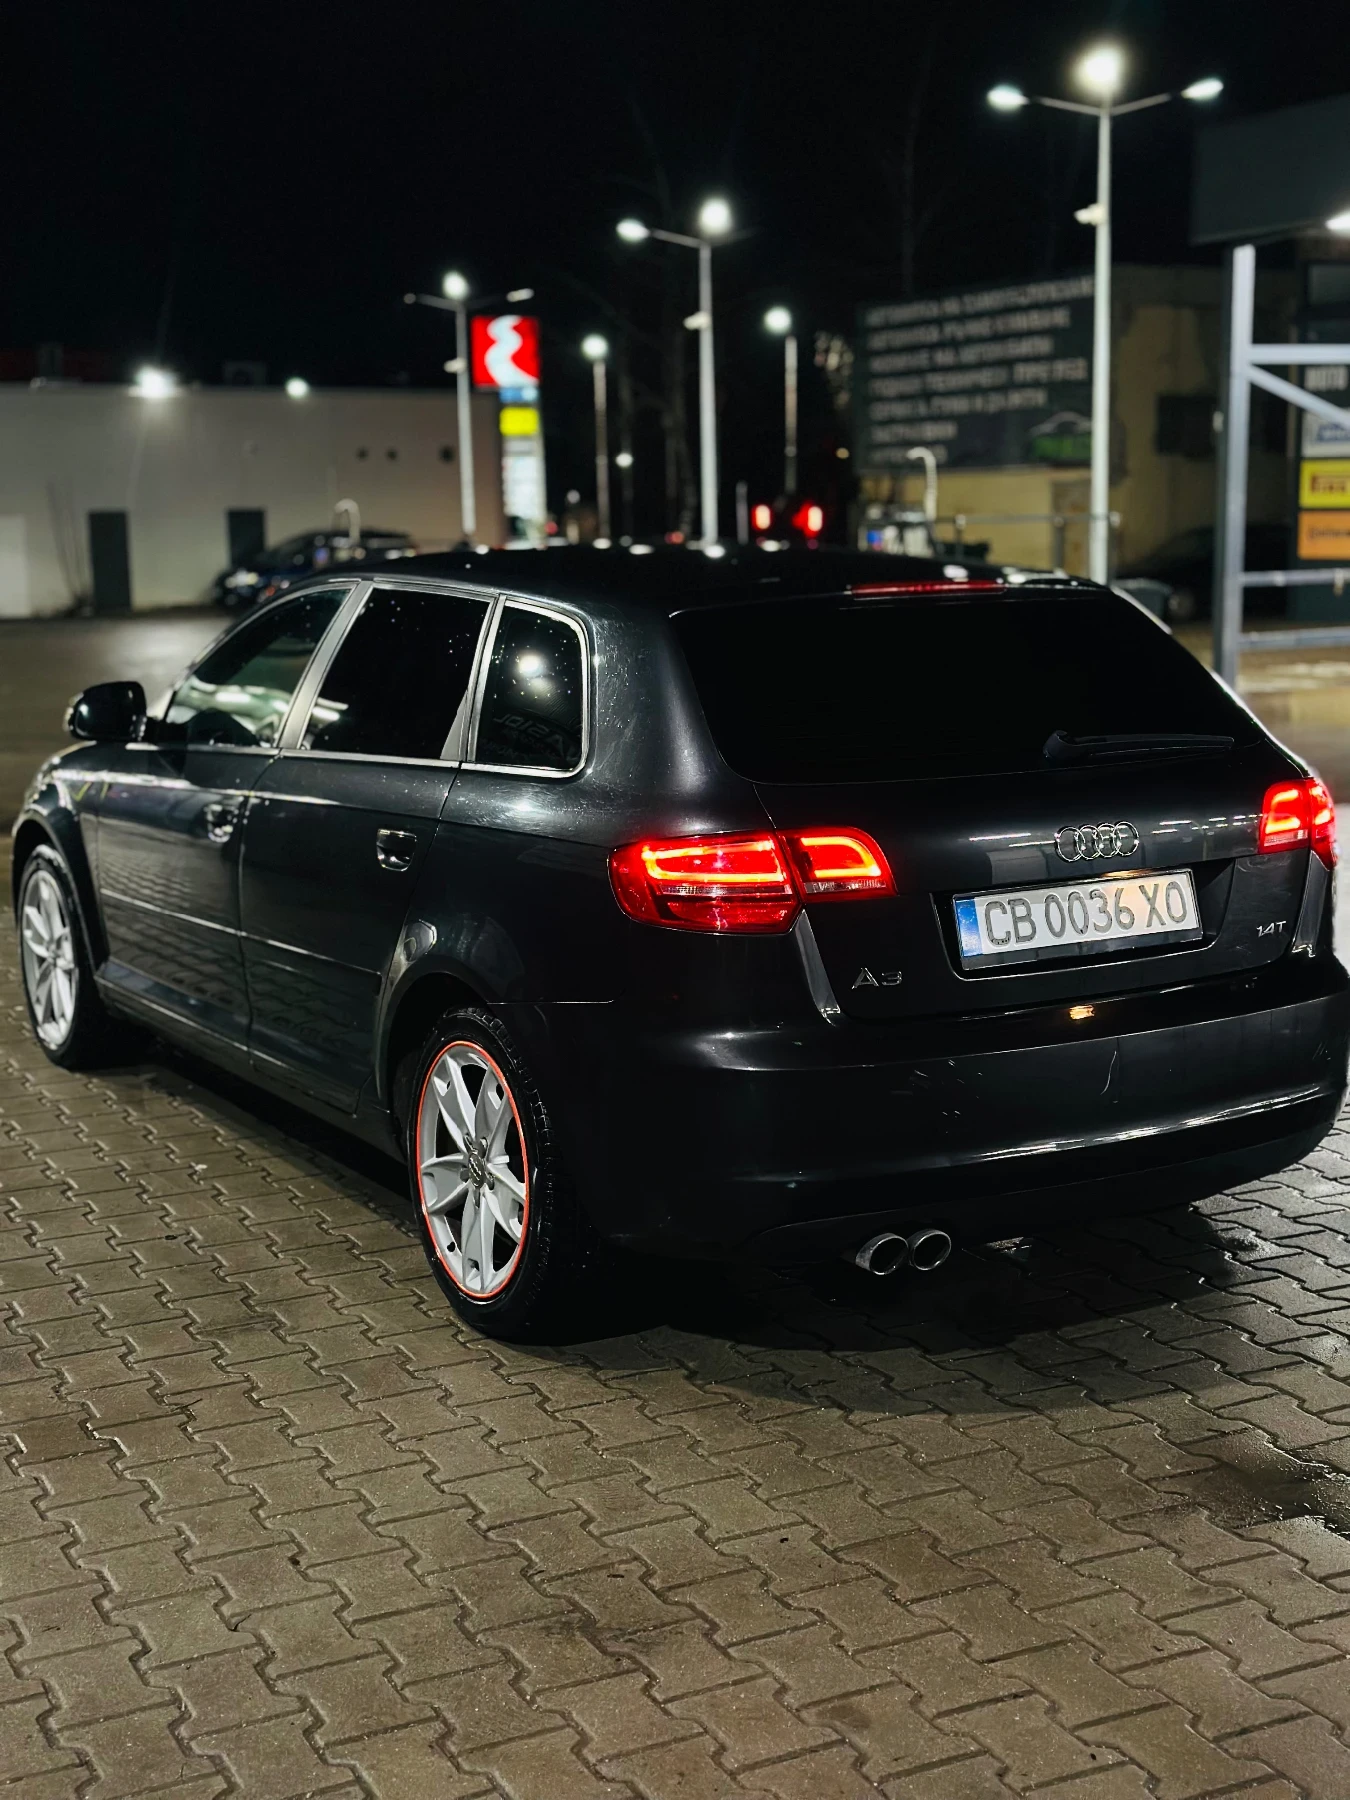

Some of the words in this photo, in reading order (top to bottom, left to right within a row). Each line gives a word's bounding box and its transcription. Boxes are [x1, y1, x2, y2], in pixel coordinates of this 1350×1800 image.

[984, 898, 1037, 946] CB
[1044, 887, 1135, 939] 0036
[1138, 881, 1188, 928] XO
[851, 966, 903, 990] A3
